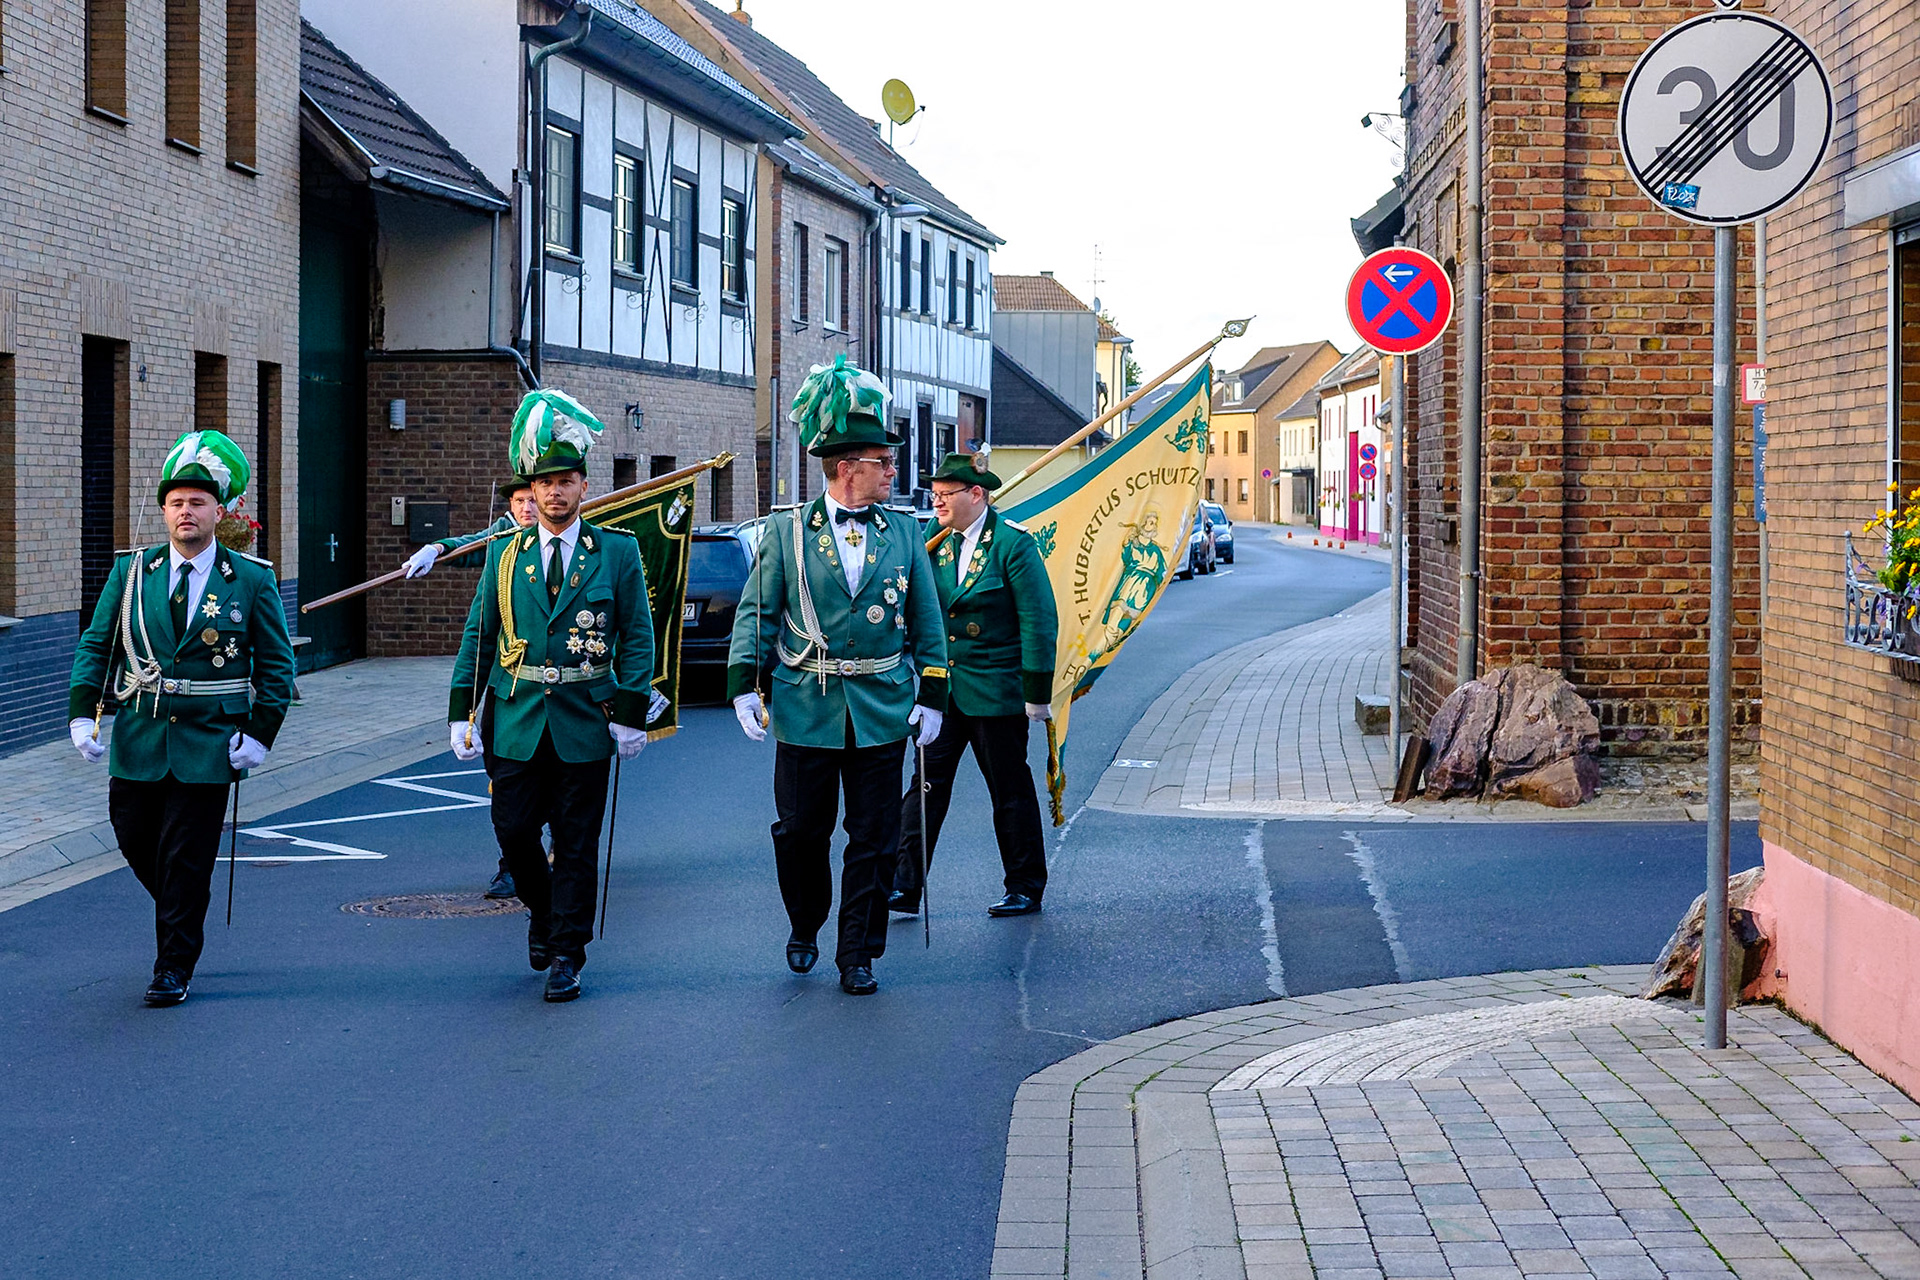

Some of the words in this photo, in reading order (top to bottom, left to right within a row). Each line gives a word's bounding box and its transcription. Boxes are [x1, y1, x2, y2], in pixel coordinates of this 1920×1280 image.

[1655, 62, 1795, 173] 30
[1074, 488, 1121, 605] HUBERTUS
[1125, 466, 1201, 497] SCHÜTZ
